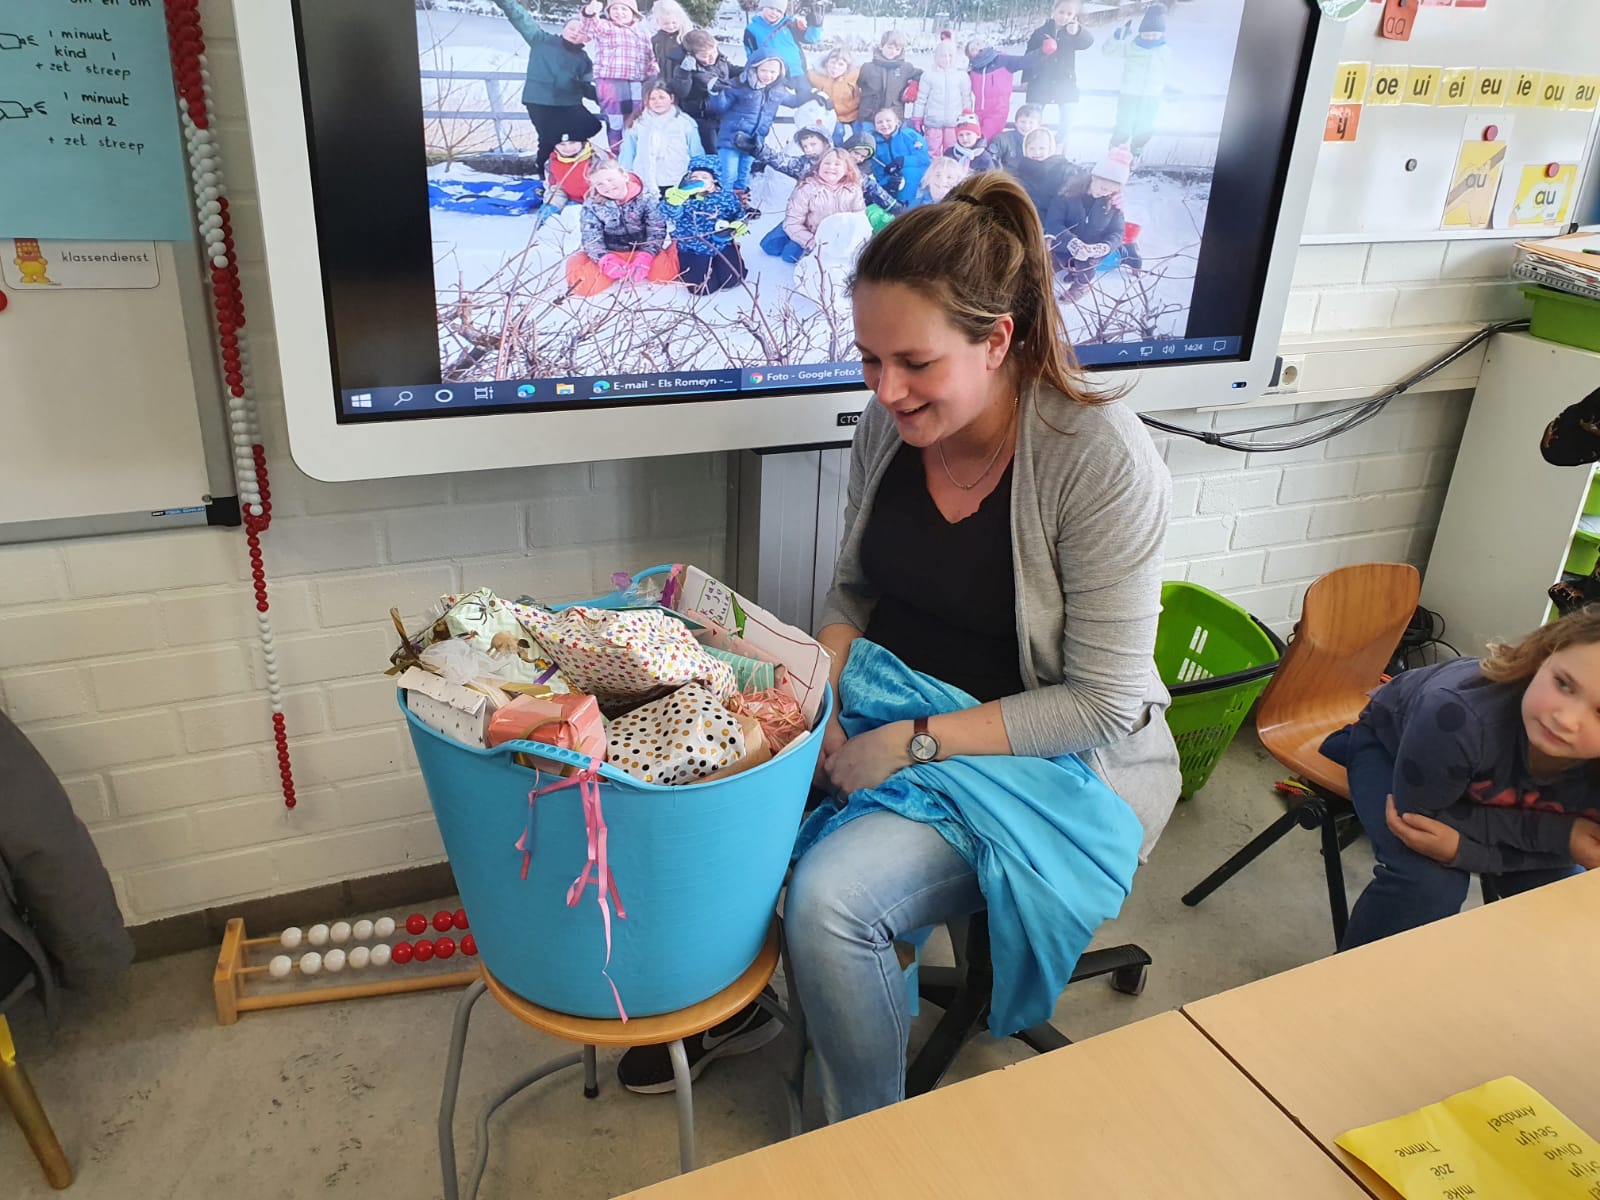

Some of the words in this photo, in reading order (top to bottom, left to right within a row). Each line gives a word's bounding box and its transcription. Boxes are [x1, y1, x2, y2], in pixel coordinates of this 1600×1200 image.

[61, 28, 112, 42] minuut
[54, 45, 87, 59] kind
[50, 61, 72, 73] zet
[86, 63, 131, 80] streep
[1343, 71, 1357, 99] ij
[1376, 77, 1398, 96] oe
[1413, 74, 1431, 97] ui
[1448, 76, 1467, 98] ei
[1480, 77, 1502, 96] eu
[1516, 76, 1532, 96] ie
[1544, 83, 1565, 101] ou
[1575, 83, 1595, 101] au
[81, 91, 130, 106] minuut
[71, 113, 102, 126] kind
[106, 116, 117, 127] 2
[64, 134, 88, 146] zet
[99, 136, 145, 155] streep
[1535, 189, 1557, 205] au
[61, 251, 150, 263] klassendienst
[613, 380, 648, 391] E-mail
[658, 378, 672, 389] Els
[674, 377, 717, 388] Romeyn
[767, 372, 789, 382] Foto
[798, 370, 833, 383] Google
[840, 415, 860, 424] CTO
[1487, 1105, 1537, 1133] Annabel
[1515, 1125, 1558, 1146] Sevijn
[1394, 1141, 1441, 1158] Timme
[1543, 1143, 1583, 1161] Olivia
